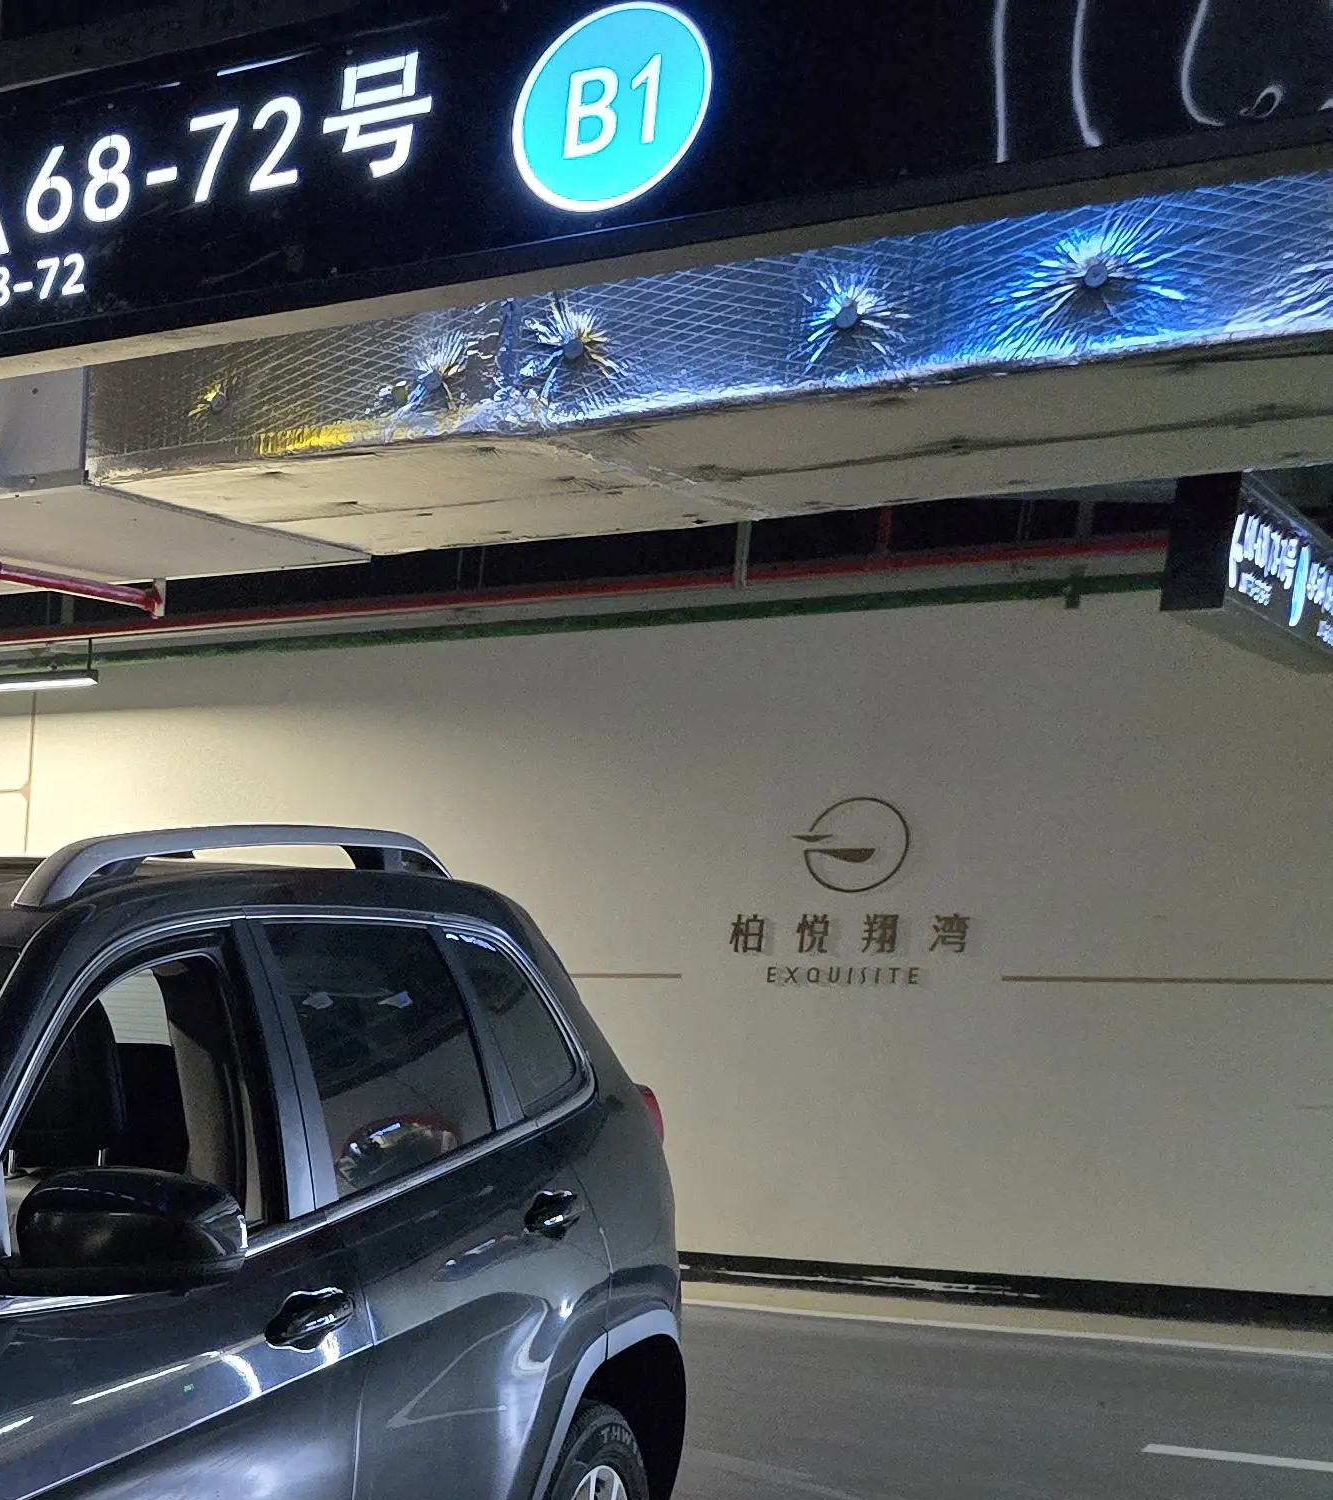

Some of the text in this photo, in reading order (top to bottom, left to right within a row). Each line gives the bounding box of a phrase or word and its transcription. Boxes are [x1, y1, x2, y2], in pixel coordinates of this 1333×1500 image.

[563, 52, 662, 160] B1
[729, 912, 970, 954] 柏悦翔湾
[766, 966, 921, 985] EXQUISITE
